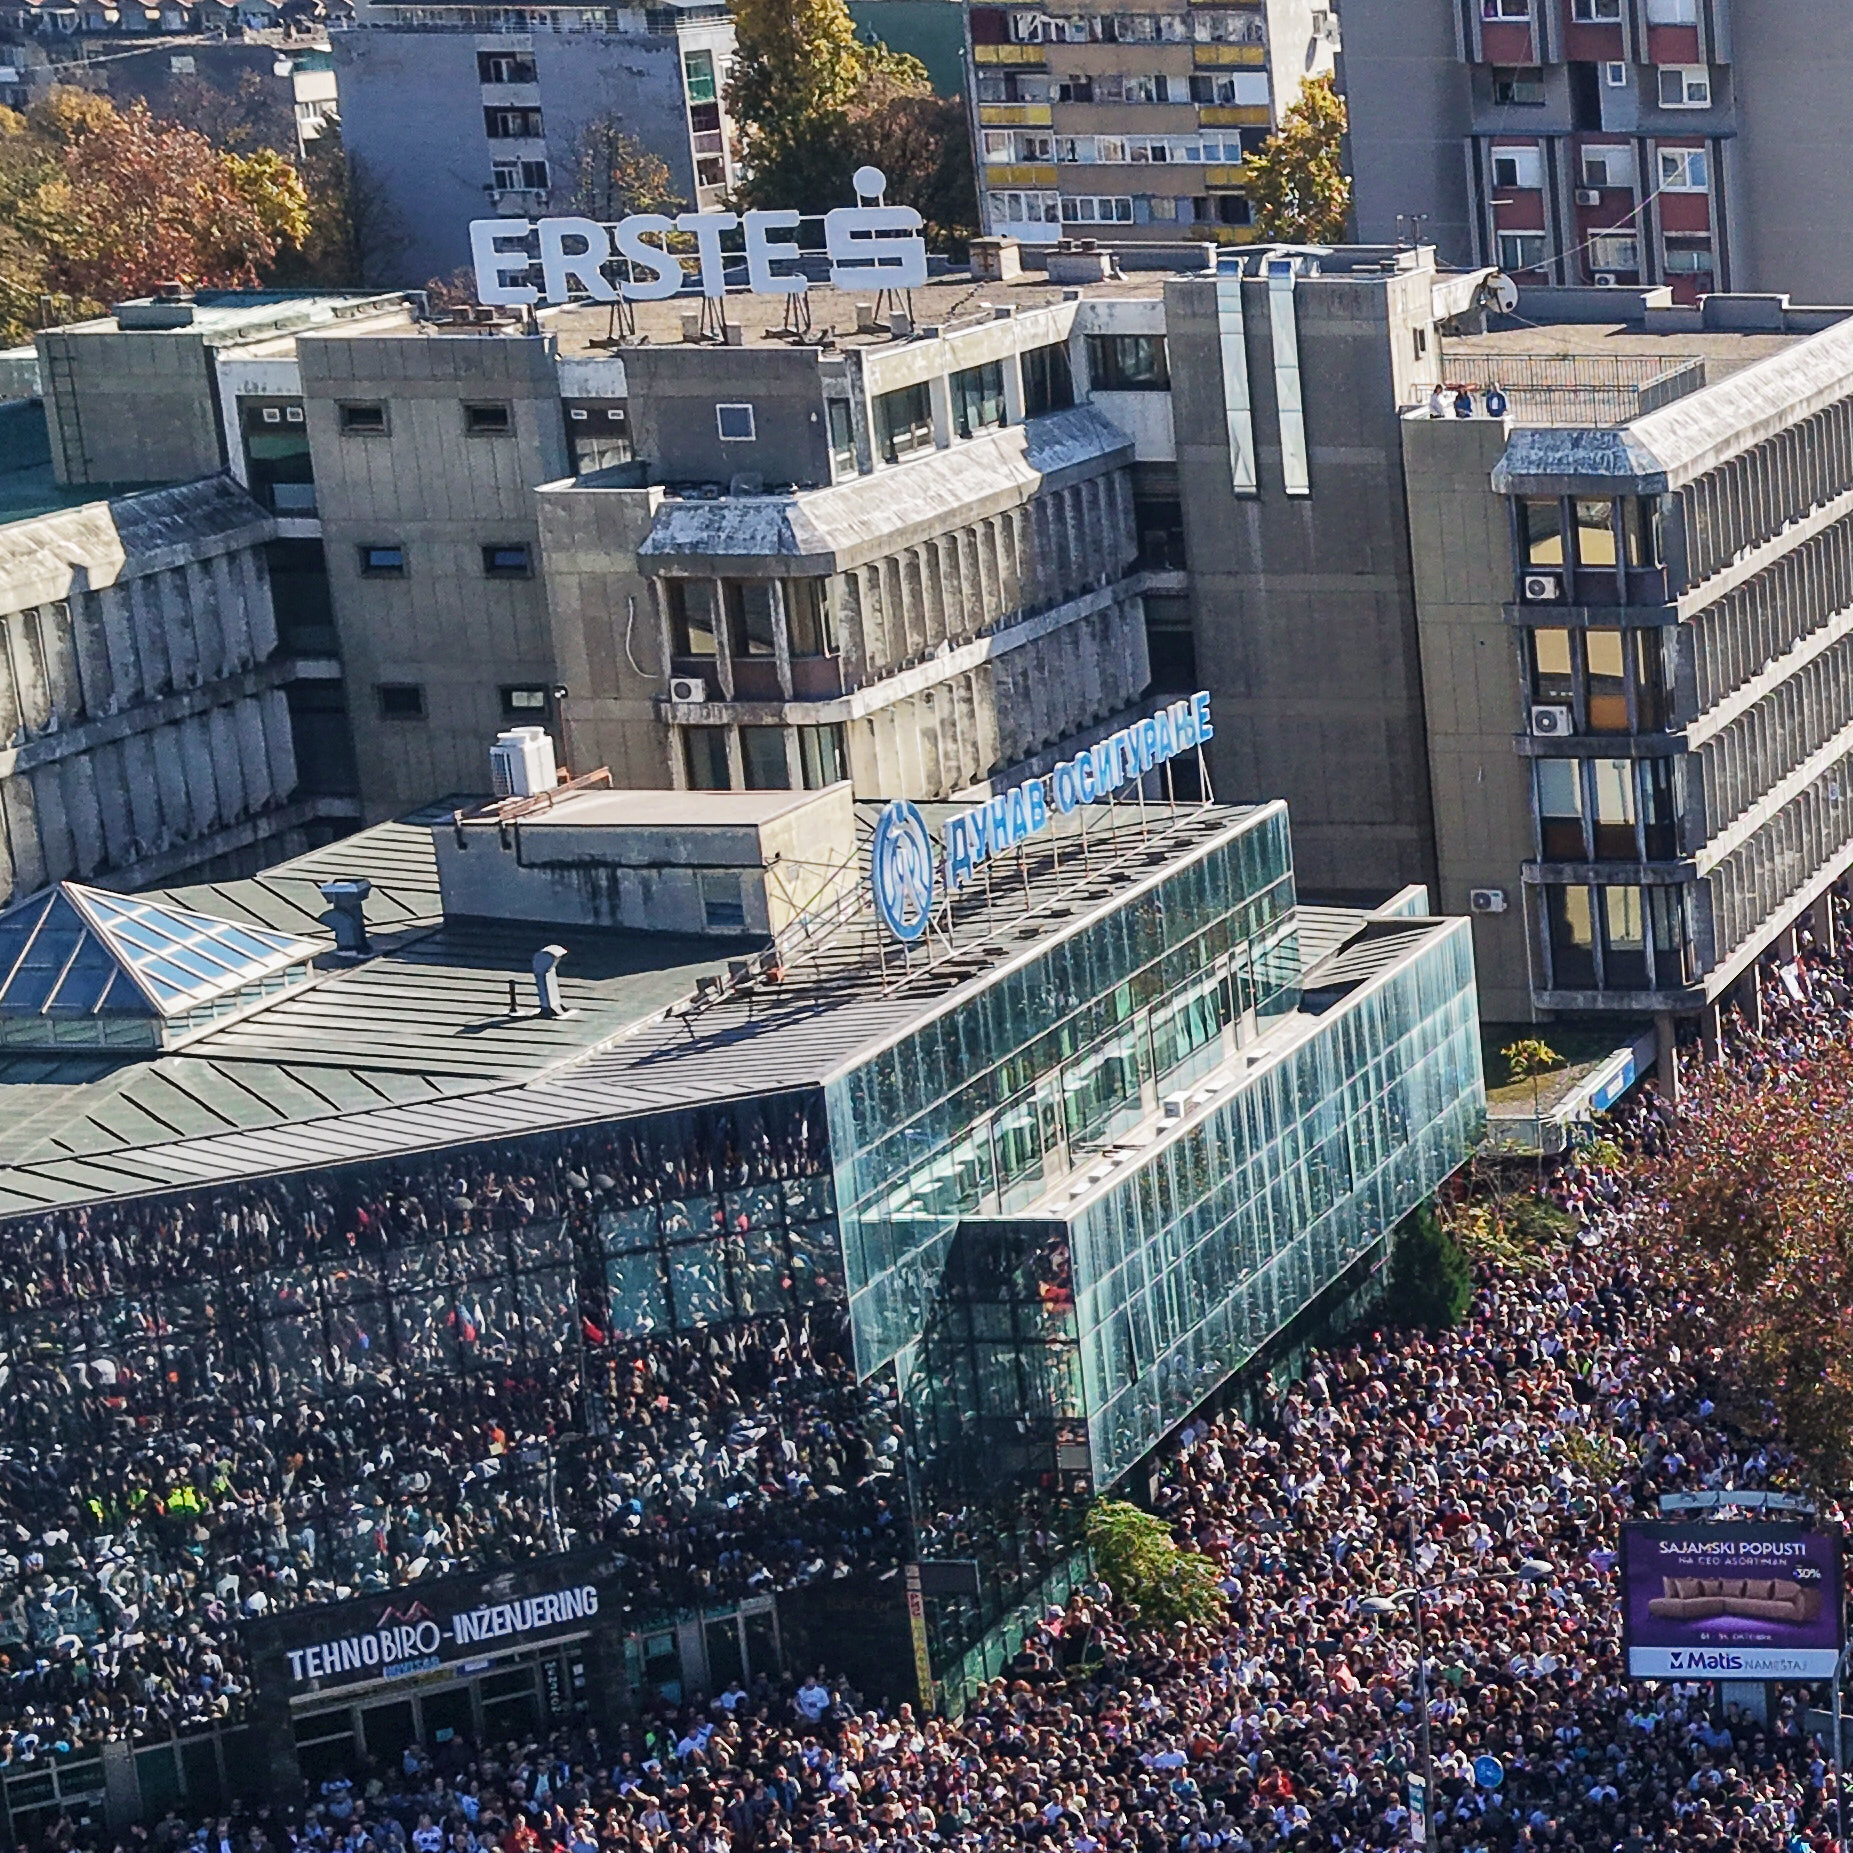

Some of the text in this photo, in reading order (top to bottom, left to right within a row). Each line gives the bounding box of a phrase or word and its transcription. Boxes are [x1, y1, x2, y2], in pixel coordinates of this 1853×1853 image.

[469, 209, 807, 305] ERSTE
[944, 690, 1213, 891] ДУНАВ ОСИГУРАЊЕ
[1659, 1541, 1806, 1555] SAJAMSKI POPUSTI
[1698, 1557, 1720, 1565] CEO
[1687, 1652, 1743, 1669] Matis
